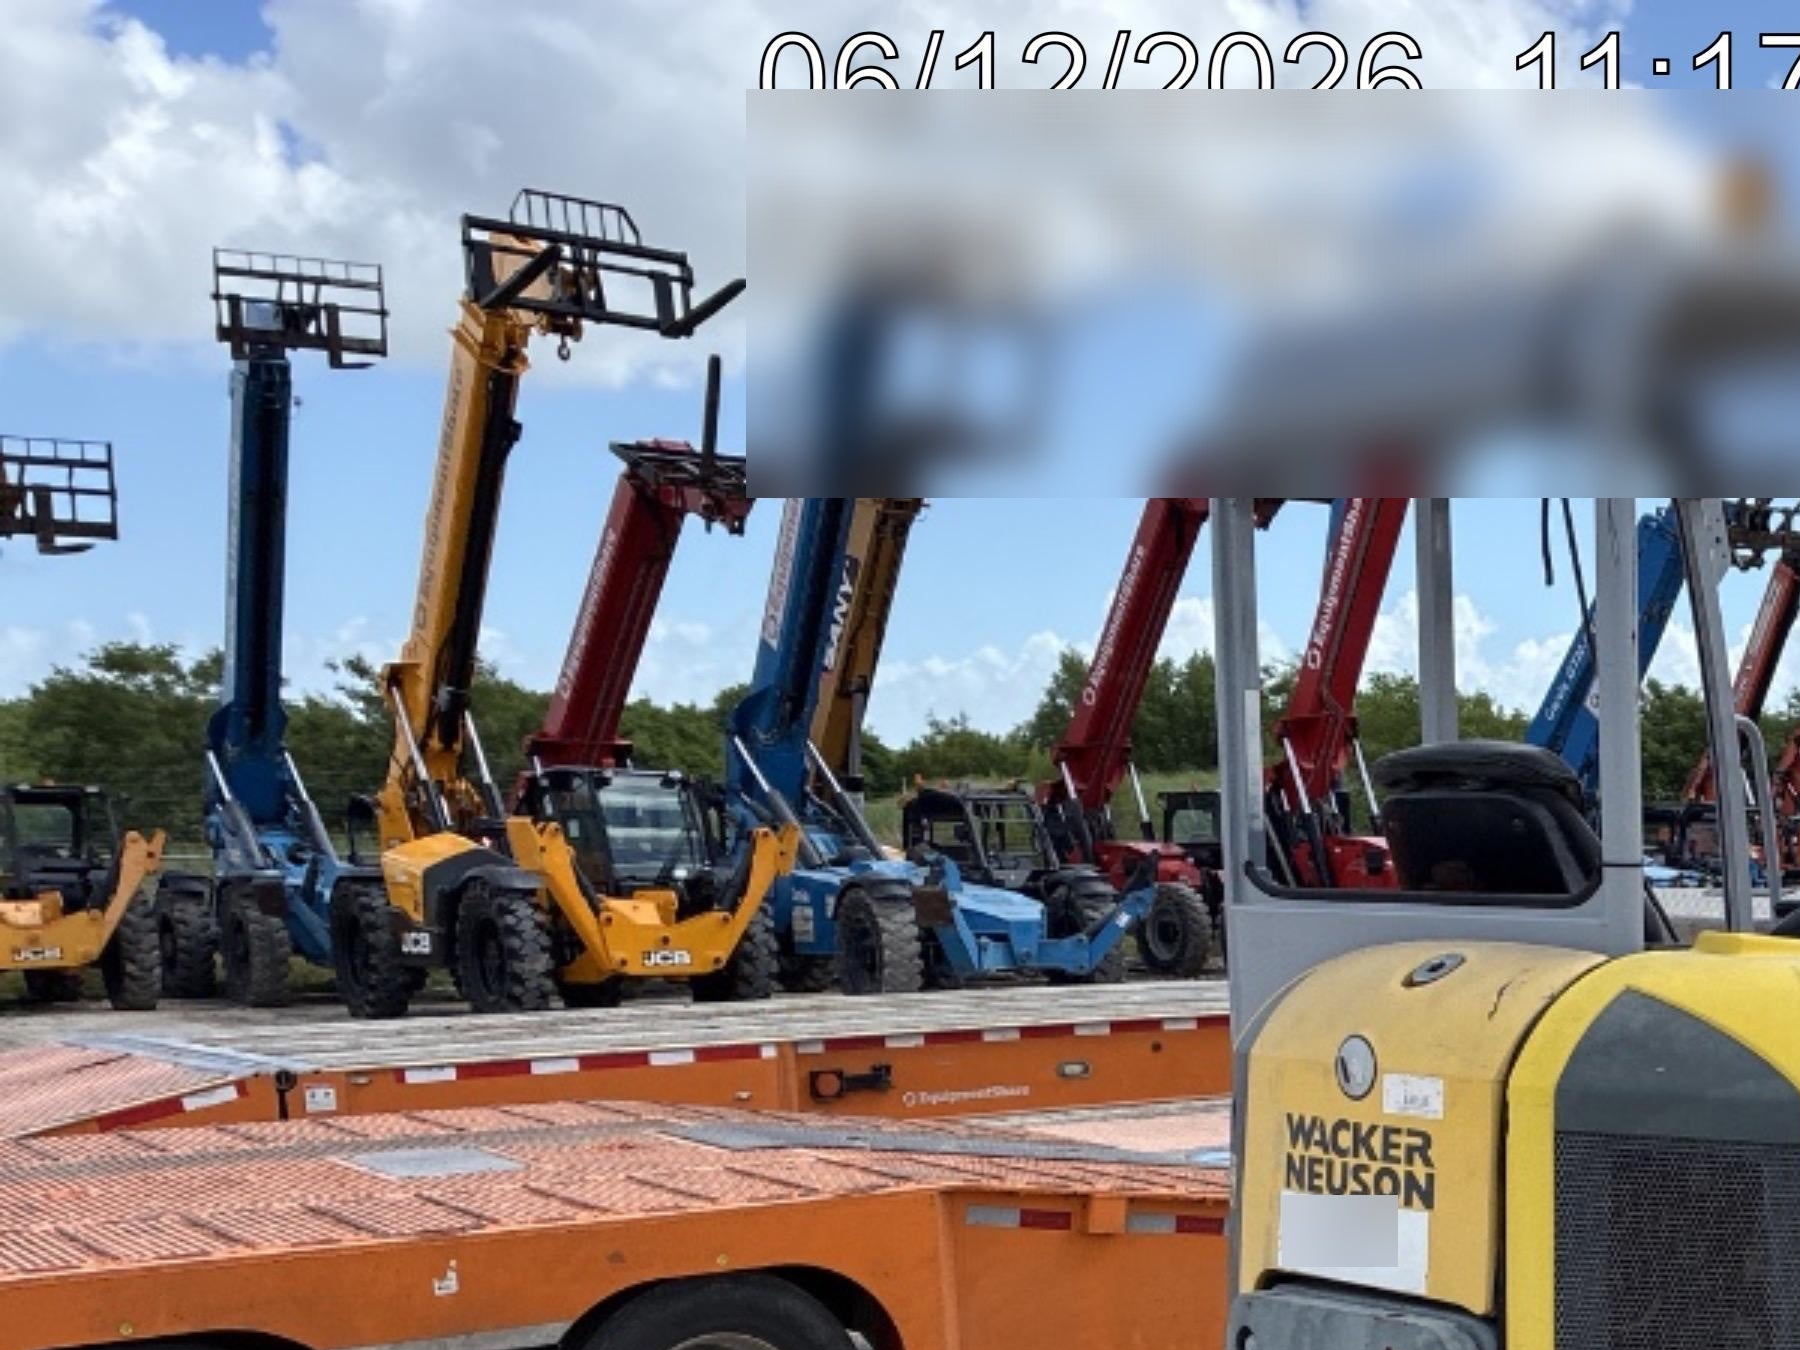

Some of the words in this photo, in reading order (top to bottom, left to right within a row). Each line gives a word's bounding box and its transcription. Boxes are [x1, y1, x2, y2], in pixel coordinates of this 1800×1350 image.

[643, 951, 691, 967] JCB
[1286, 1112, 1435, 1168] WACKER
[1286, 1151, 1435, 1210] NEUSON
